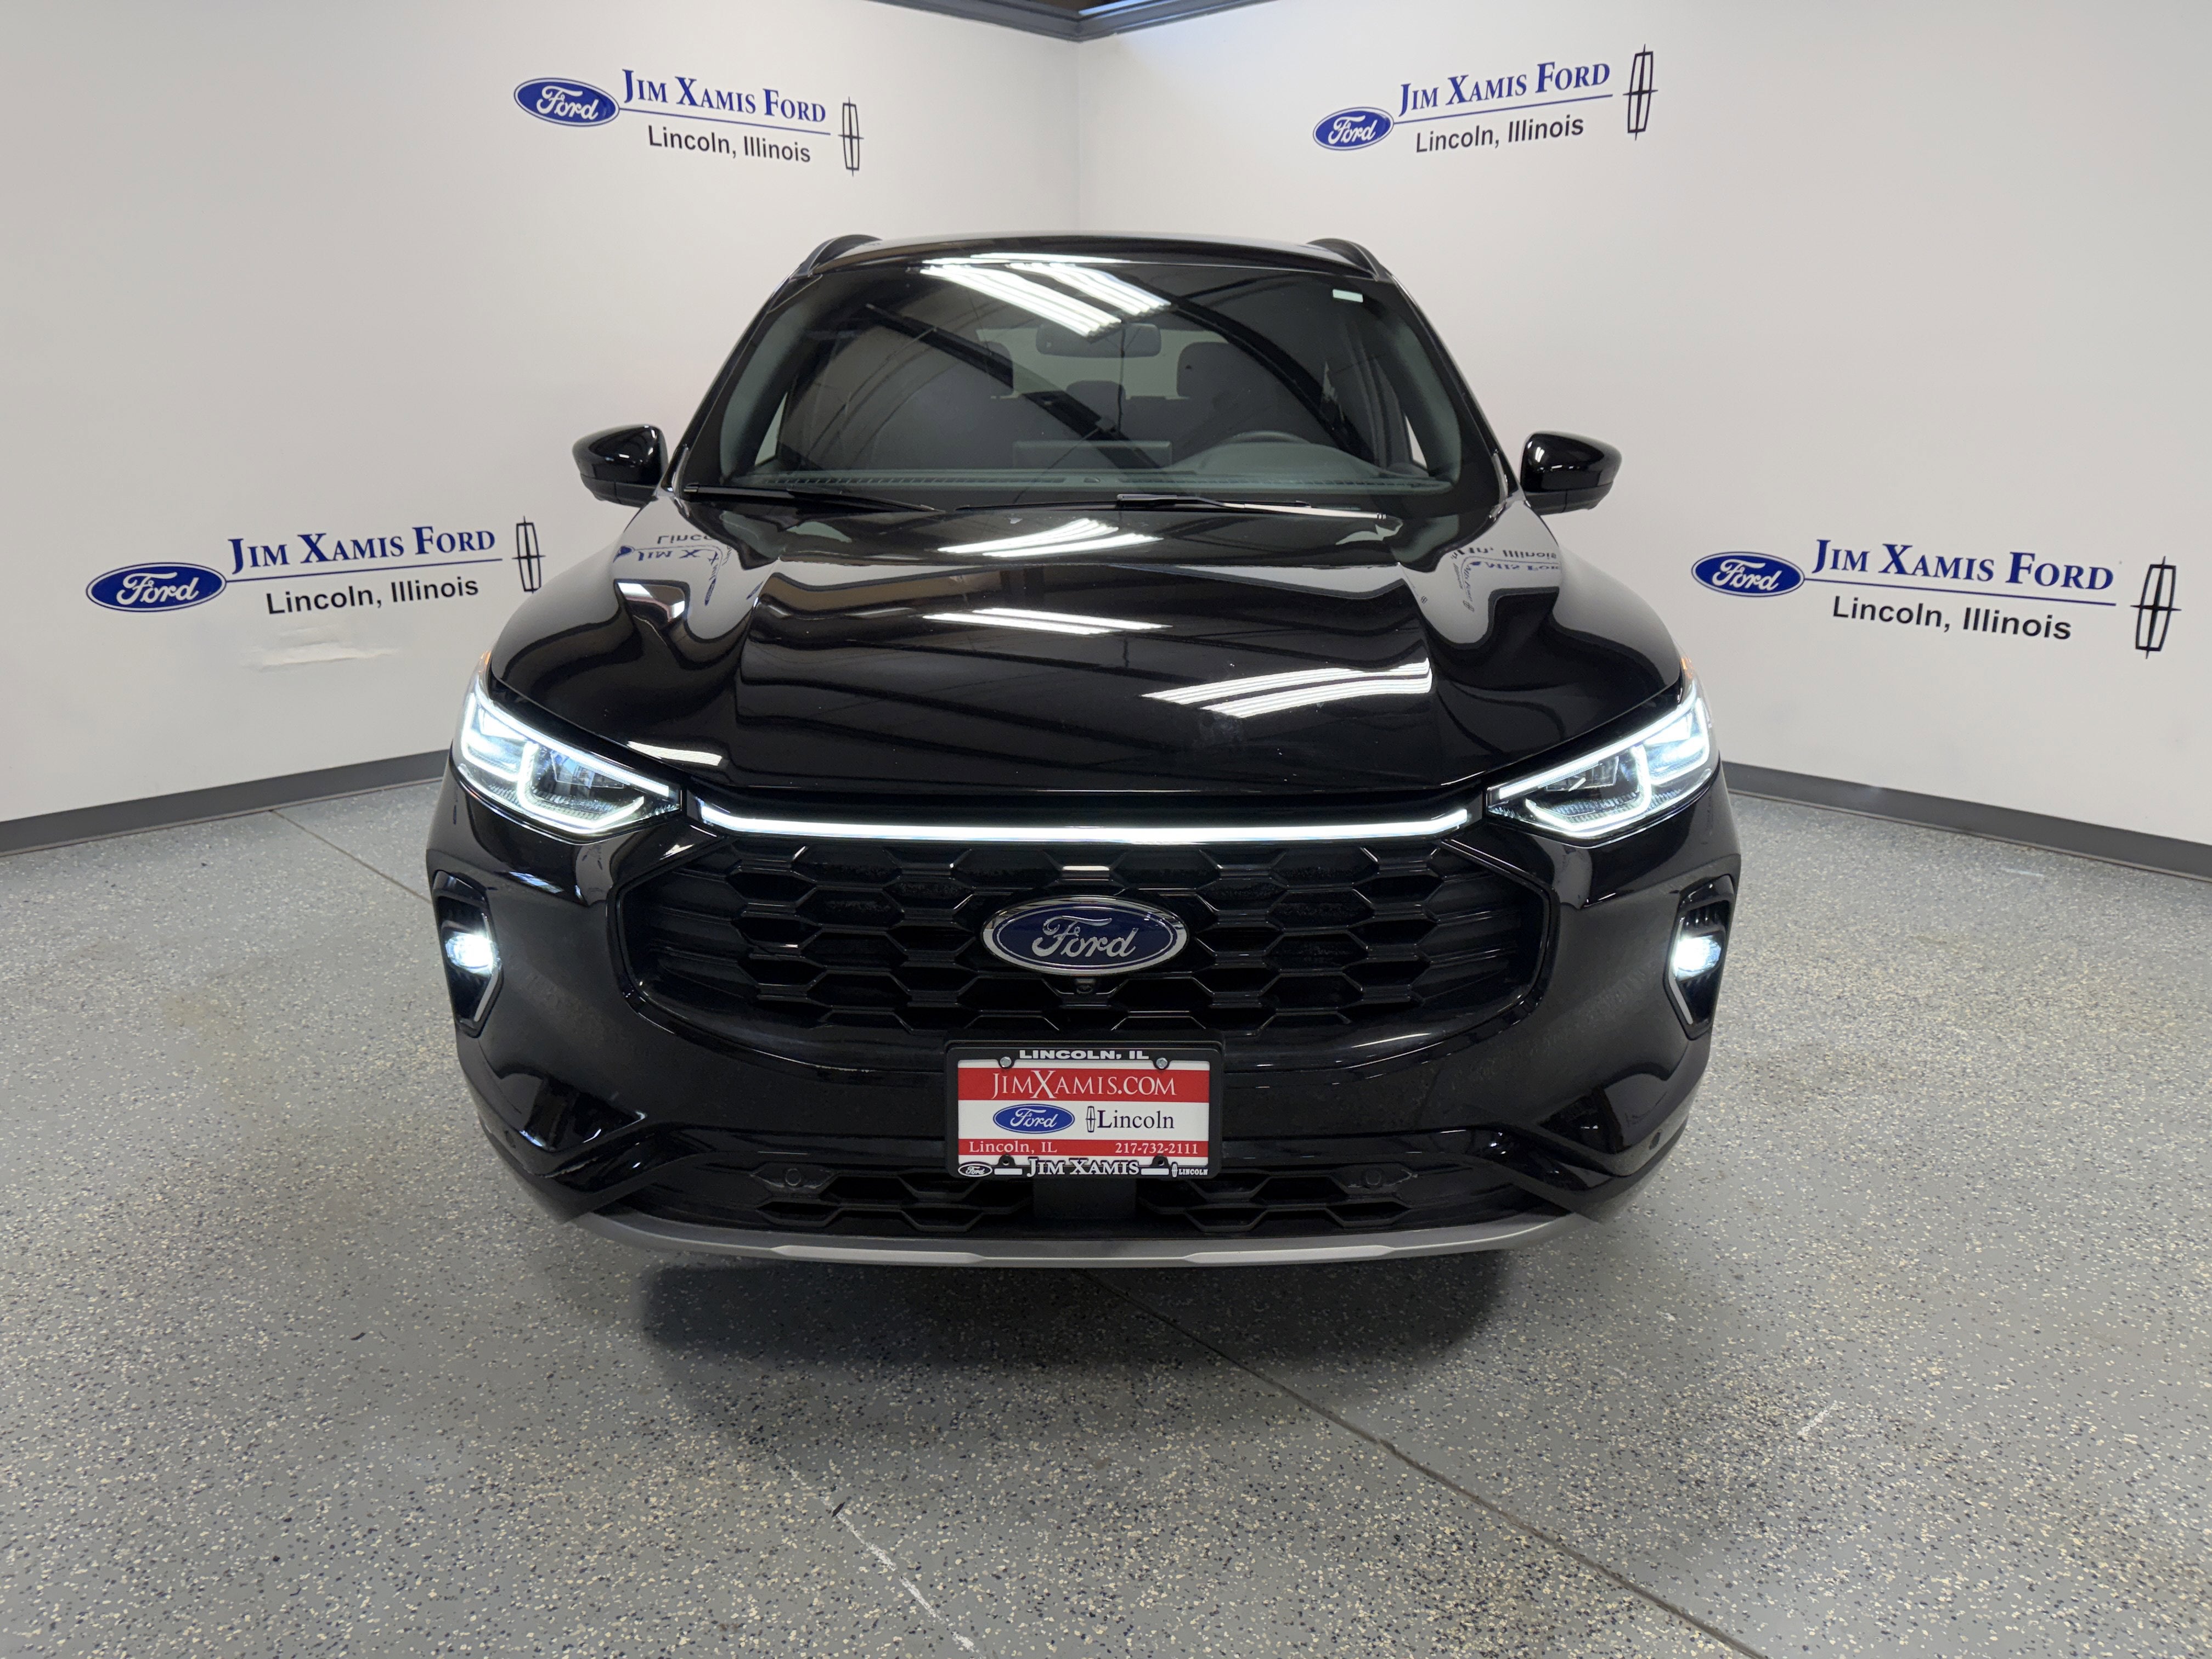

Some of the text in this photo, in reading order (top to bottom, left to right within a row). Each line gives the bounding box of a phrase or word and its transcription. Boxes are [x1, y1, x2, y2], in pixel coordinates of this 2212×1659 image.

[536, 85, 600, 122] Ford
[622, 69, 826, 122] JIM XAMIS FORD
[1398, 61, 1611, 117] JIM XAMIS FORD
[648, 125, 811, 162] Lincoln, Illinois
[1328, 115, 1377, 144] Ford
[1415, 114, 1584, 153] Lincoln, Illinois
[227, 526, 496, 575] JIM XAMIS FORD
[1812, 539, 2114, 591] JIM XAMIS FORD
[116, 571, 199, 605] Ford
[1711, 558, 1780, 592] Ford
[266, 576, 479, 614] Lincoln, Illinois
[1832, 595, 2072, 640] Lincoln, Illinois
[1031, 915, 1139, 958] Ford
[1019, 1049, 1149, 1060] LINCOLN, IL
[1009, 1109, 1058, 1128] Ford
[1097, 1109, 1175, 1130] Lincoln
[969, 1141, 1058, 1154] Lincoln, IL
[1115, 1143, 1198, 1154] 217-732-2111
[965, 1166, 985, 1175] Ford
[1026, 1158, 1140, 1178] JIM XAMIS
